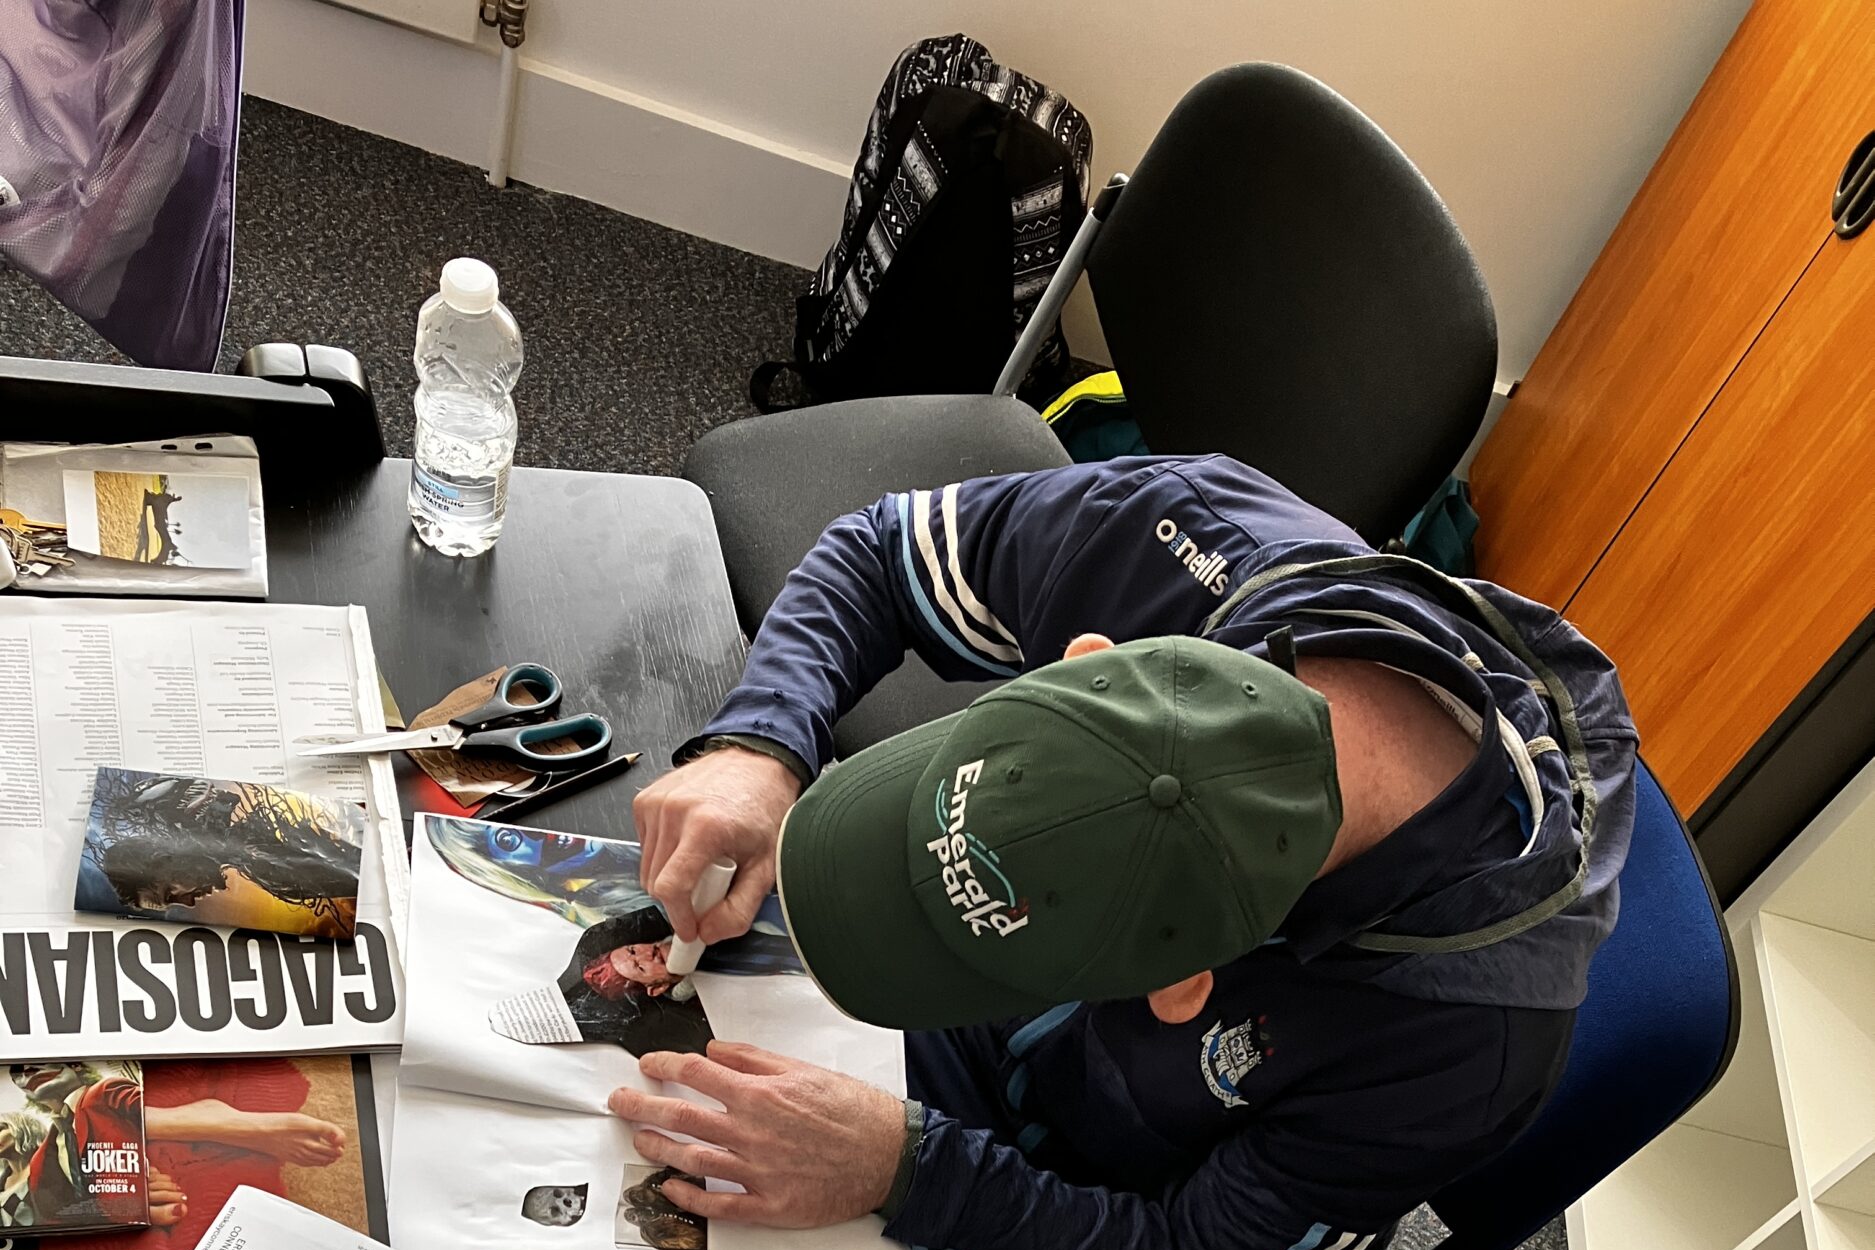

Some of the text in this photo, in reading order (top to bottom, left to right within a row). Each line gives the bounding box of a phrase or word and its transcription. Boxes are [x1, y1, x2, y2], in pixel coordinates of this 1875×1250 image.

[422, 492, 450, 512] WATER
[948, 759, 1029, 937] Emerald
[81, 1149, 140, 1173] JOKER
[88, 1184, 136, 1193] OCTOBER 4
